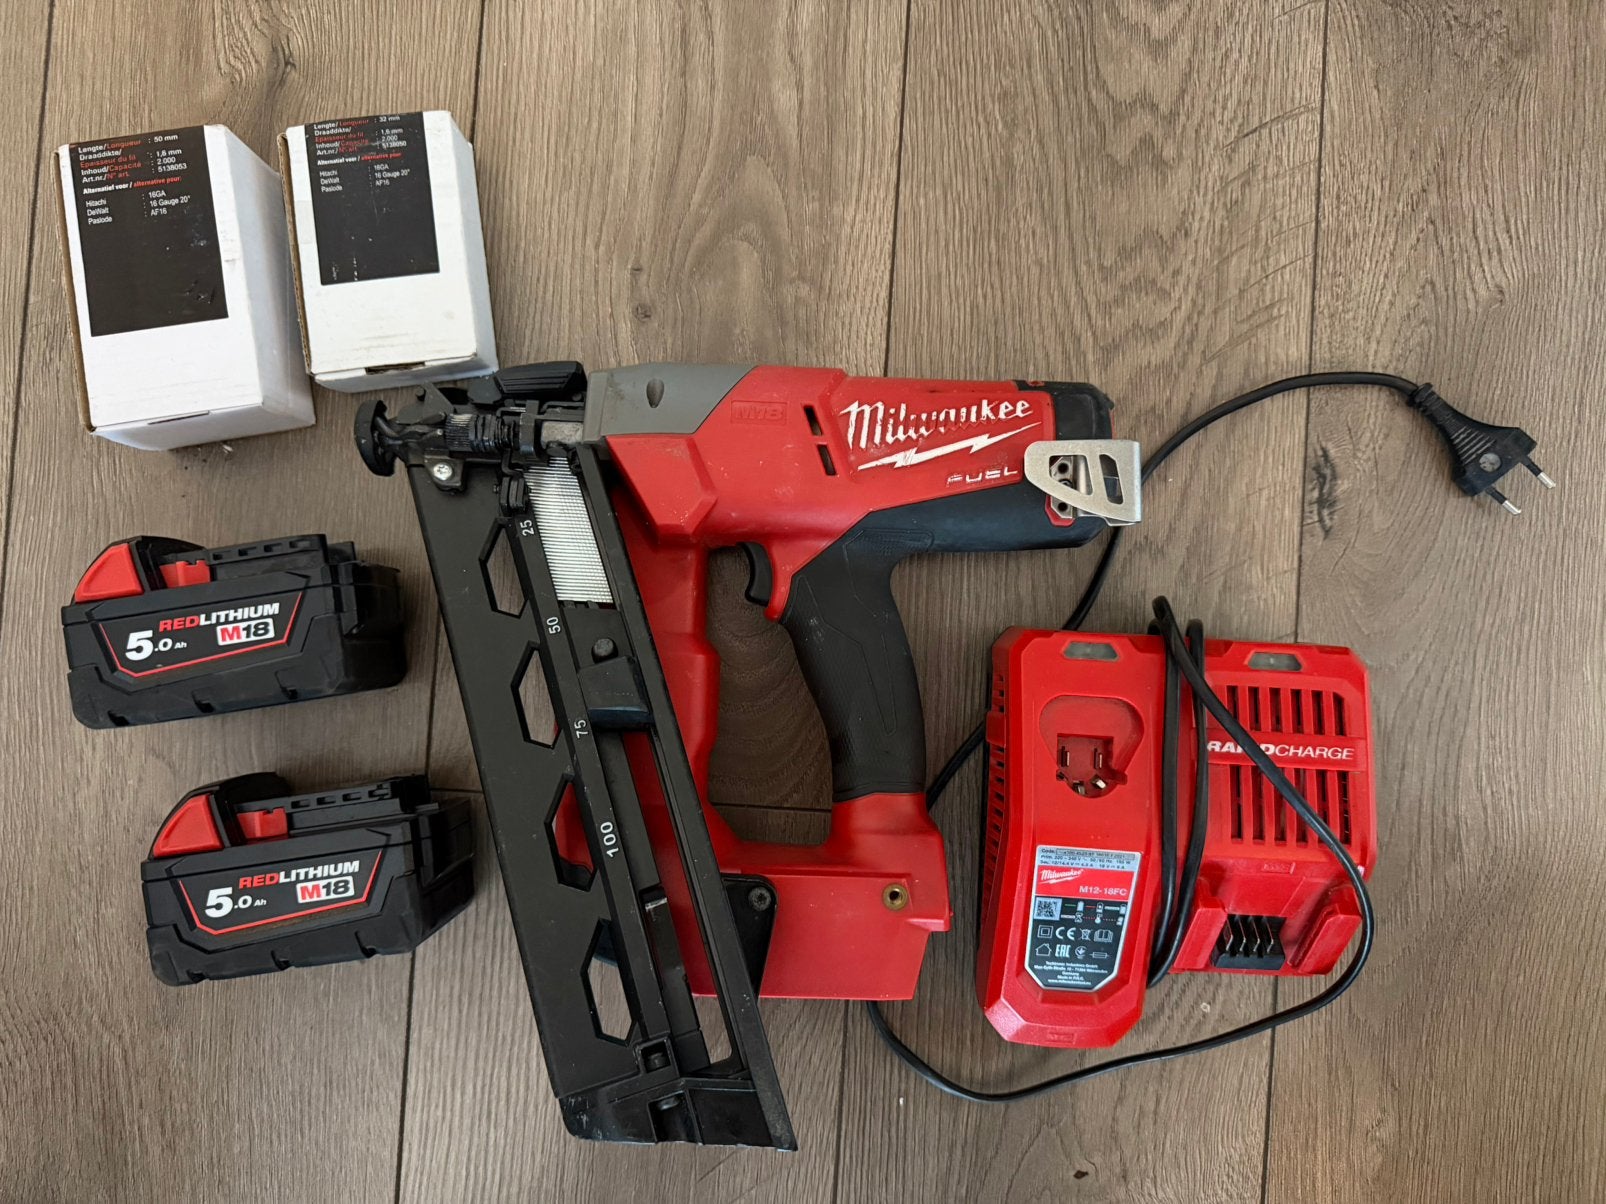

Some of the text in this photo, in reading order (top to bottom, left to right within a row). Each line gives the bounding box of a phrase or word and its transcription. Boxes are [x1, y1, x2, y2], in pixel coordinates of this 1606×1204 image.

[157, 157, 176, 165] 2.000
[382, 170, 400, 178] Gauge
[83, 184, 115, 195] Alternatief
[86, 190, 166, 207] Hitachi 16GA
[87, 207, 110, 216] DeWalt
[158, 197, 179, 206] Gauge
[88, 208, 167, 225] Paslode AF16
[946, 466, 1018, 488] FUEL
[520, 520, 534, 536] 25
[158, 602, 280, 633] REDLITHIUM
[546, 616, 560, 634] 50
[220, 621, 271, 643] M18
[174, 642, 187, 650] Ah
[574, 719, 588, 738] 75
[1207, 740, 1355, 760] RADCHARGE
[600, 822, 619, 857] 100
[239, 860, 360, 889] REDLITHIUM
[300, 879, 351, 900] M18
[1079, 886, 1128, 896] M12-18FC
[254, 898, 267, 907] Ah
